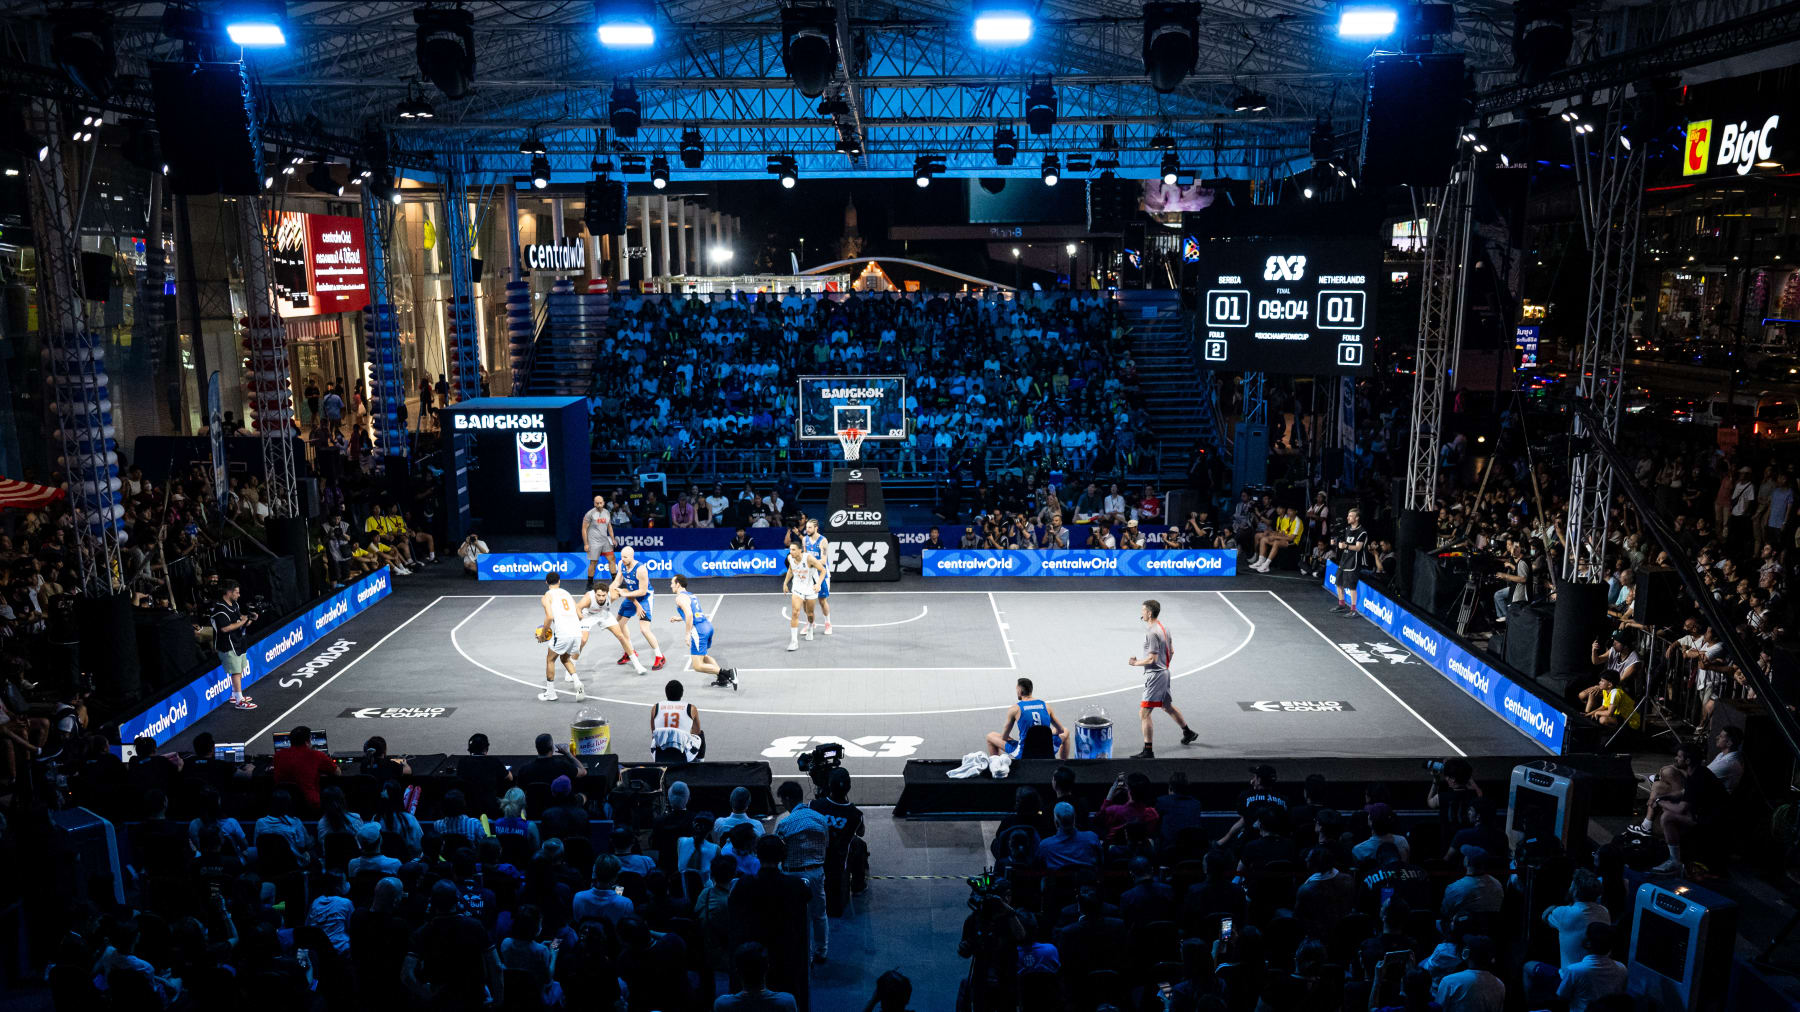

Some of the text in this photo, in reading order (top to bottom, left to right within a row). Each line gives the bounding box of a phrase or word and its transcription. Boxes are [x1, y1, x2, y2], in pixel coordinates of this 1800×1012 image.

[1218, 275, 1242, 285] SERBIA
[1318, 275, 1366, 285] NETHERLANDS
[1276, 287, 1291, 295] FINAL
[1215, 296, 1241, 321] 01
[1258, 300, 1308, 320] 09:04
[1327, 297, 1355, 323] 01
[1208, 331, 1225, 339] FOULS
[1342, 334, 1361, 342] FOULS
[1211, 342, 1221, 357] 2
[1345, 346, 1356, 362] 0
[821, 387, 885, 399] BANGKOK
[454, 414, 545, 429] BANGKOK
[847, 511, 882, 521] TERO
[492, 560, 568, 573] centralwOrld
[701, 557, 777, 570] centralwOrld
[937, 557, 1013, 569] centralwOrld
[1041, 557, 1118, 570] centralwOrld
[1146, 557, 1222, 569] centralwOrld
[357, 575, 387, 604] centralwOrld
[315, 598, 348, 630] centralwOrld
[1363, 597, 1393, 625] centralwOrld
[265, 625, 304, 663] centralwOrld
[1402, 624, 1438, 657] centralwOrld
[1448, 657, 1490, 695] centralwOrld
[663, 711, 680, 729] 13
[1503, 696, 1555, 739] centralwOrld
